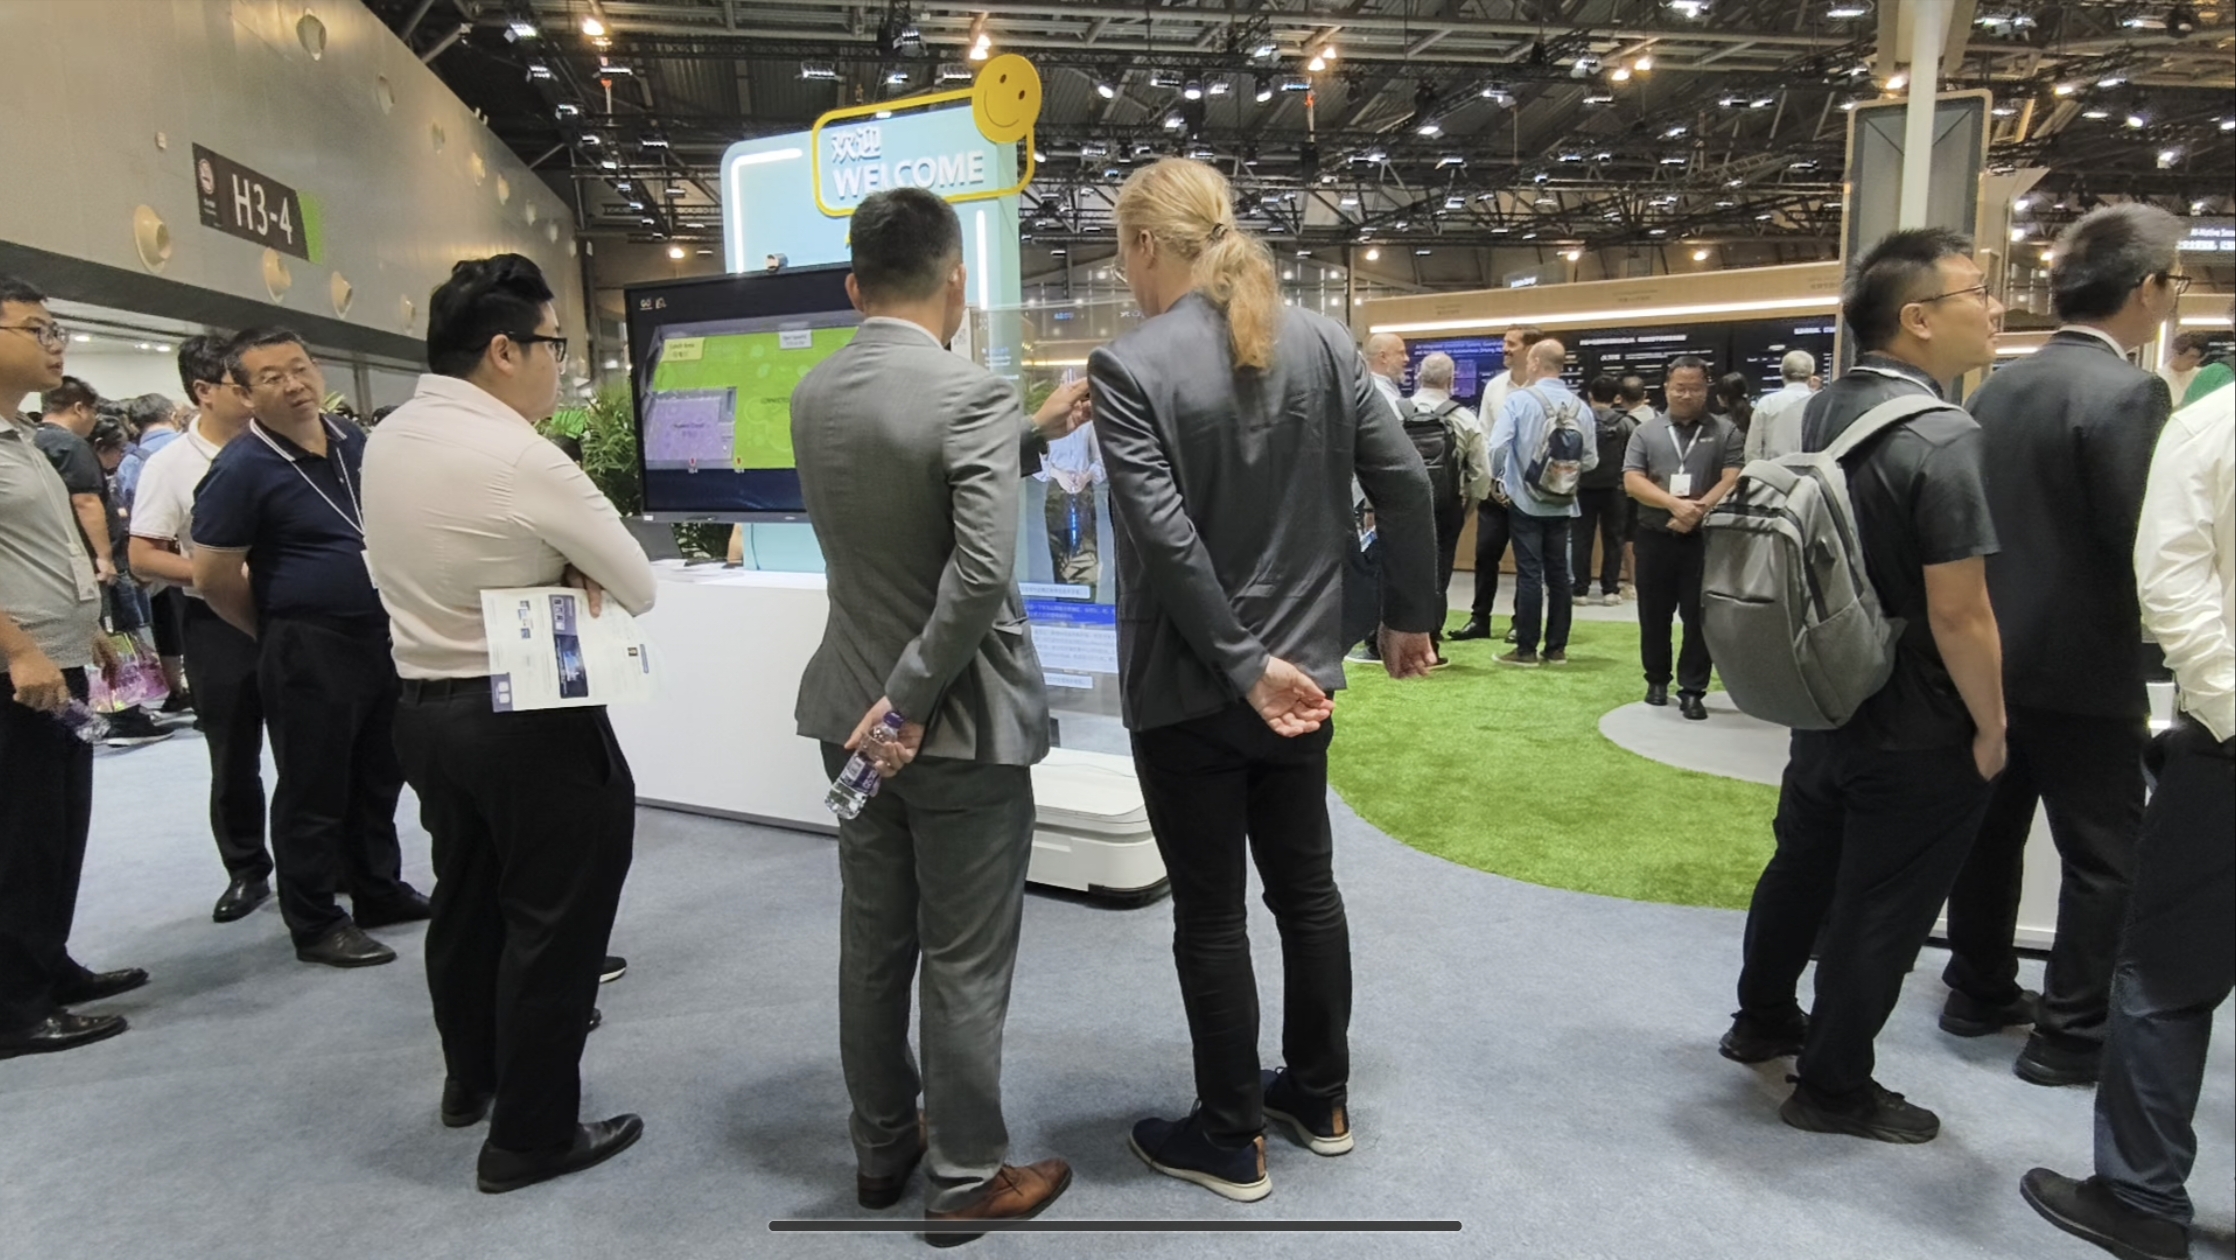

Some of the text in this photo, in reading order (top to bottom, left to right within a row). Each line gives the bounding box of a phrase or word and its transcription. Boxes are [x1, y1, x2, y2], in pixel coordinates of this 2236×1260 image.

[831, 126, 881, 164] 欢迎
[832, 151, 984, 200] WELCOME
[232, 174, 293, 245] H3-4
